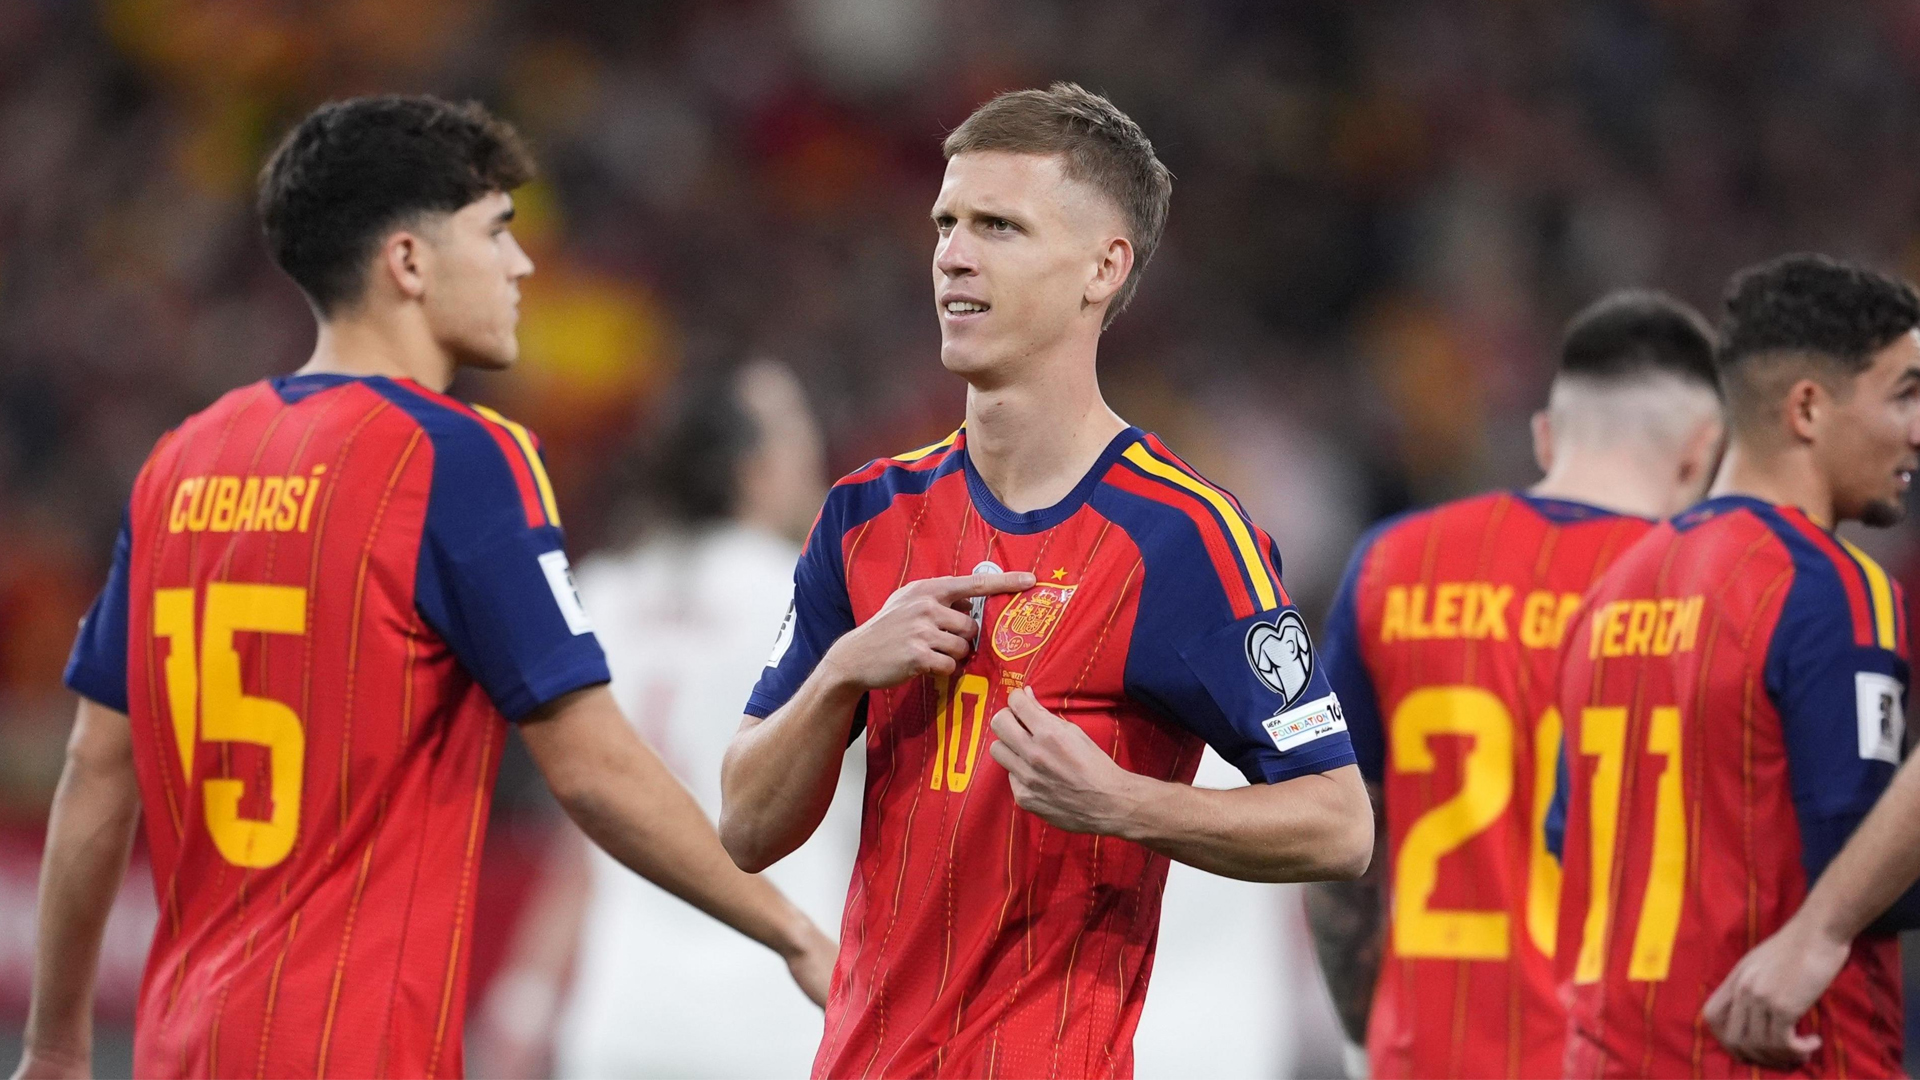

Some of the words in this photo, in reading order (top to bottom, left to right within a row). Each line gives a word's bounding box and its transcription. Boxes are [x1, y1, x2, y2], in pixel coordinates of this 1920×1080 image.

[168, 463, 328, 534] CUBARSÍ
[1381, 582, 1513, 643] ALEIX
[153, 582, 307, 869] 15
[930, 674, 989, 793] 10
[1272, 713, 1329, 737] FOUNDATION
[1574, 706, 1687, 984] 11
